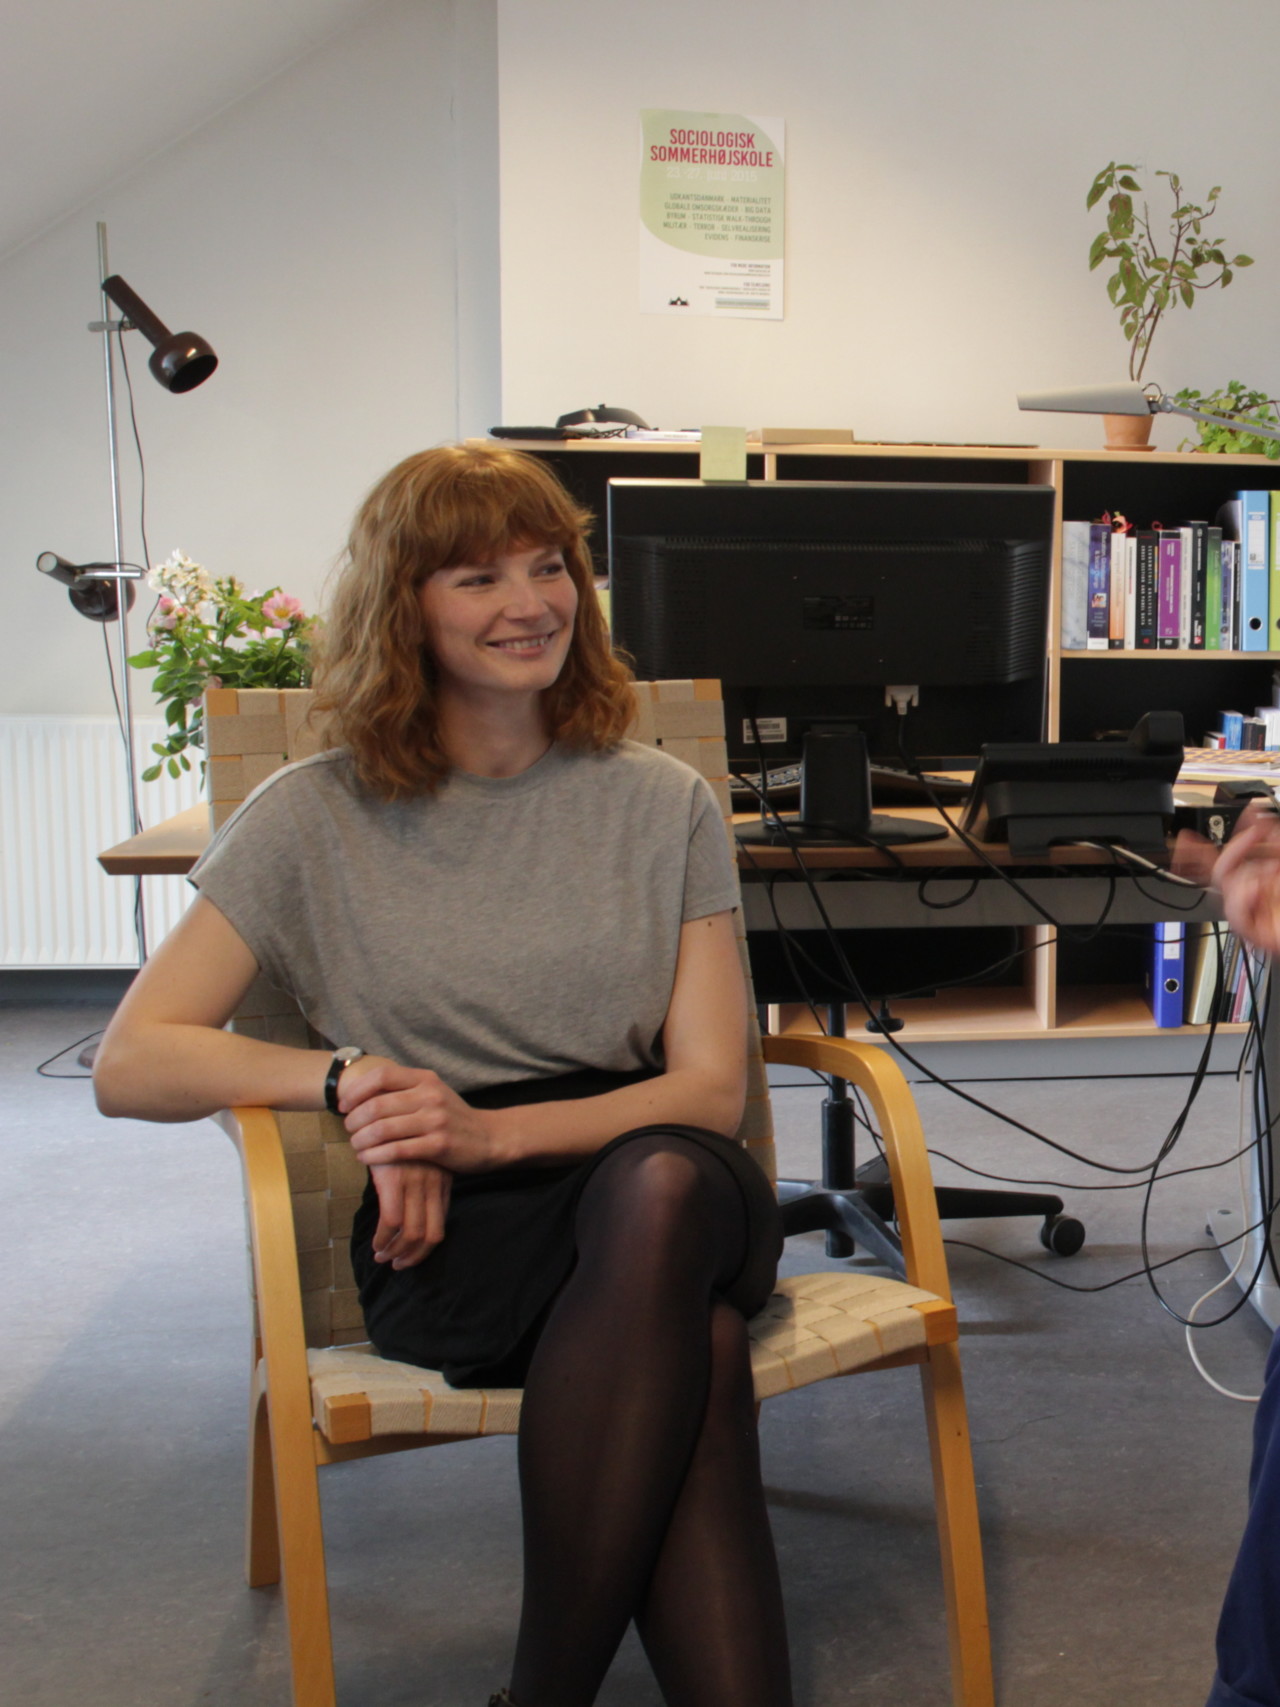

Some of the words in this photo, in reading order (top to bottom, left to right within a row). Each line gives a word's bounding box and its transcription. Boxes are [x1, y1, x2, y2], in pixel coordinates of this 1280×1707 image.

[669, 128, 755, 149] SOCIOLOGISK
[650, 145, 774, 168] SOMMERHØJSKOLE
[730, 196, 772, 205] MATERIALITET
[755, 206, 772, 215] DATA
